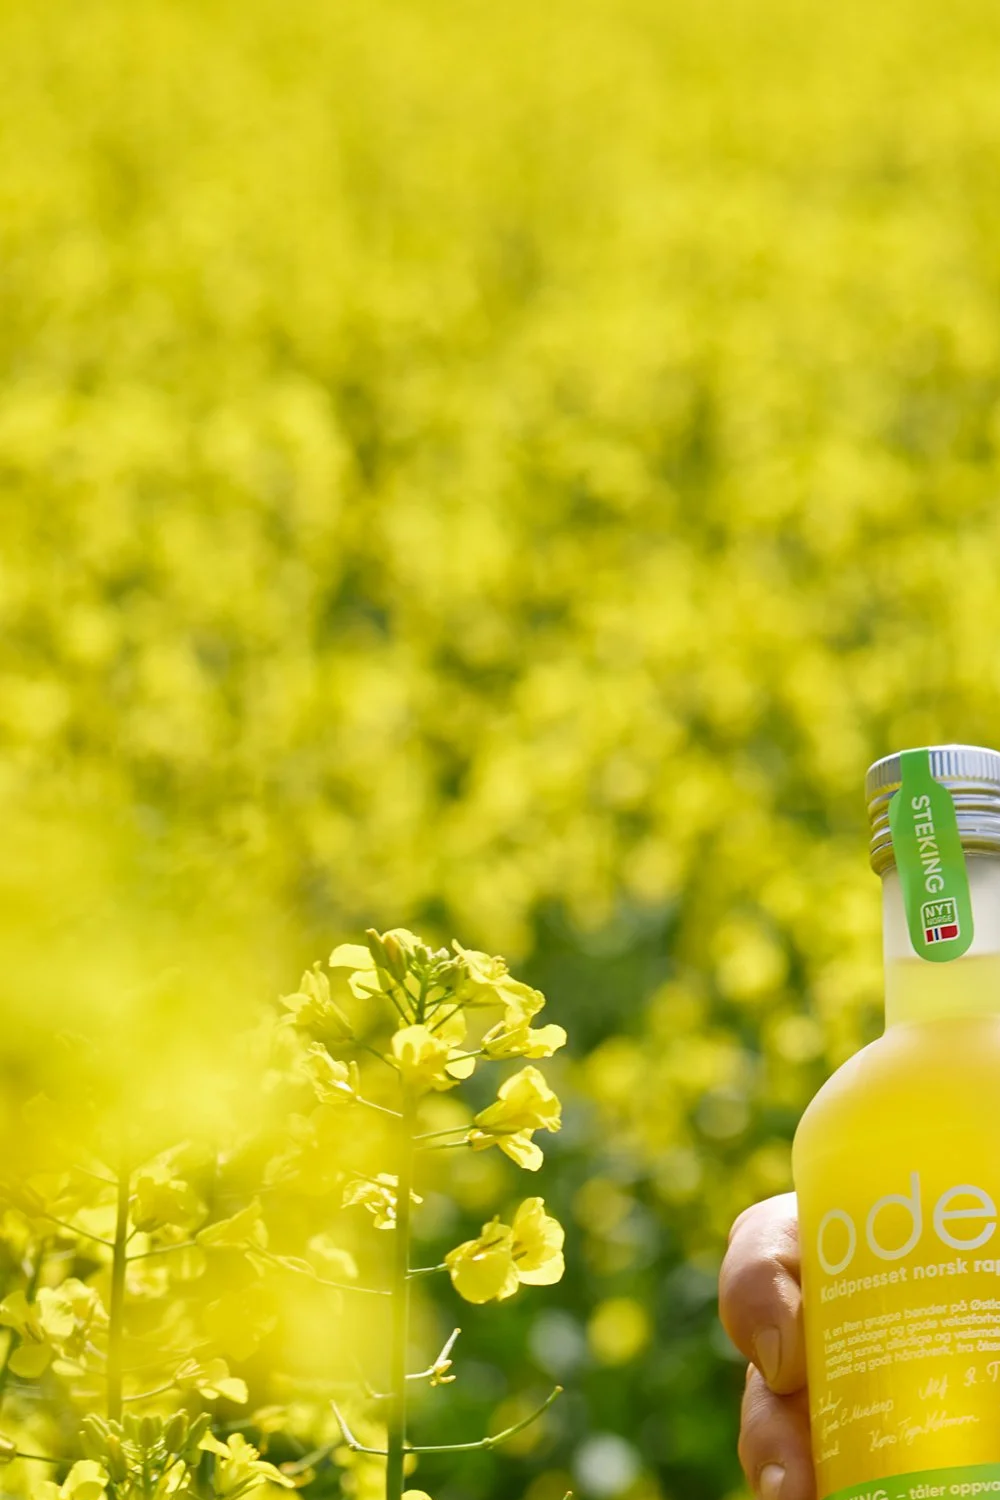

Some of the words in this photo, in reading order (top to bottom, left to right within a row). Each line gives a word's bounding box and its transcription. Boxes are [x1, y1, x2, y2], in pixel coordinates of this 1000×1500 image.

[911, 795, 945, 894] STEKING
[925, 903, 953, 919] NYT
[820, 1267, 907, 1304] Kaldpresset
[913, 1258, 968, 1281] norsk
[889, 1325, 904, 1337] og
[934, 1332, 951, 1344] og
[853, 1361, 867, 1373] og
[910, 1481, 946, 1500] tåler
